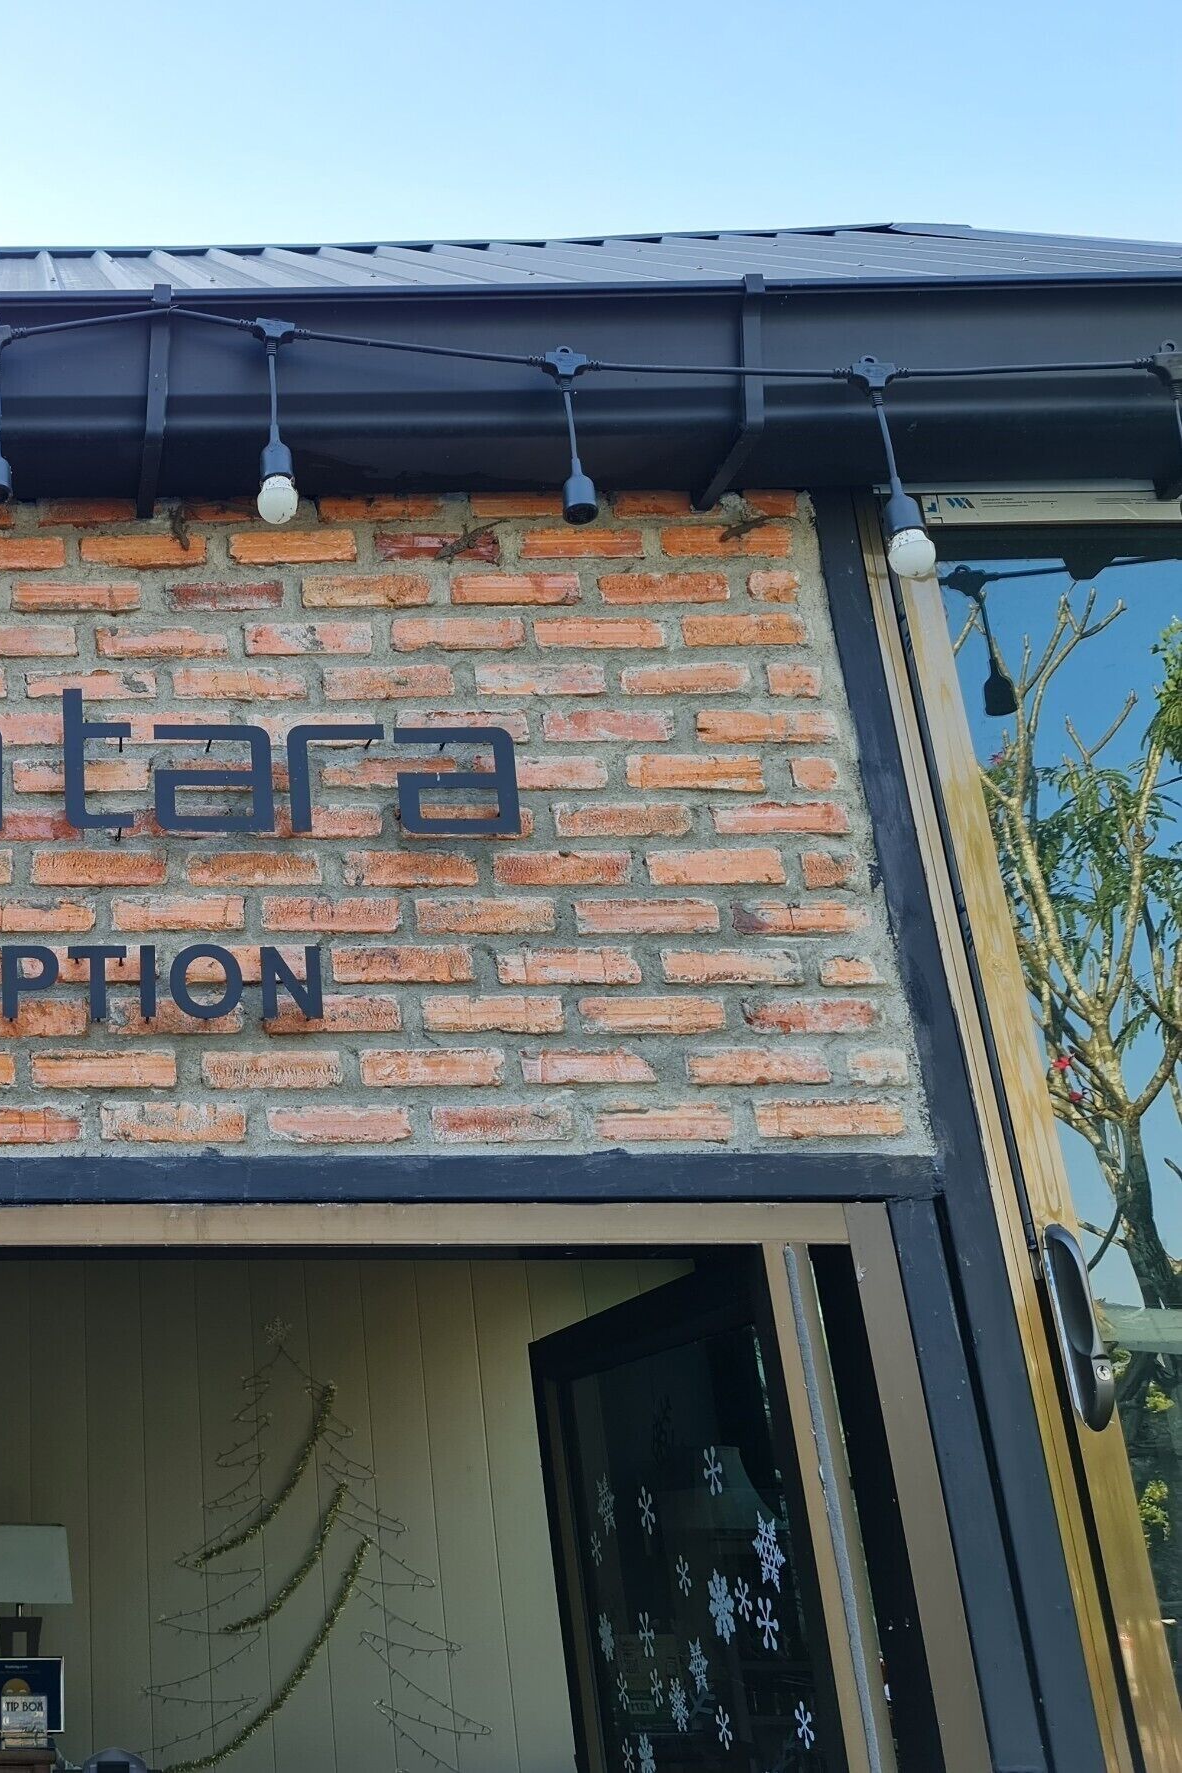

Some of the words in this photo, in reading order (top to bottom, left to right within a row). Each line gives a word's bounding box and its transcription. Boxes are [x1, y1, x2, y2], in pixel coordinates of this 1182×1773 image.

[62, 688, 520, 834] tara
[5, 1701, 19, 1712] TIP
[22, 1701, 44, 1712] BOX
